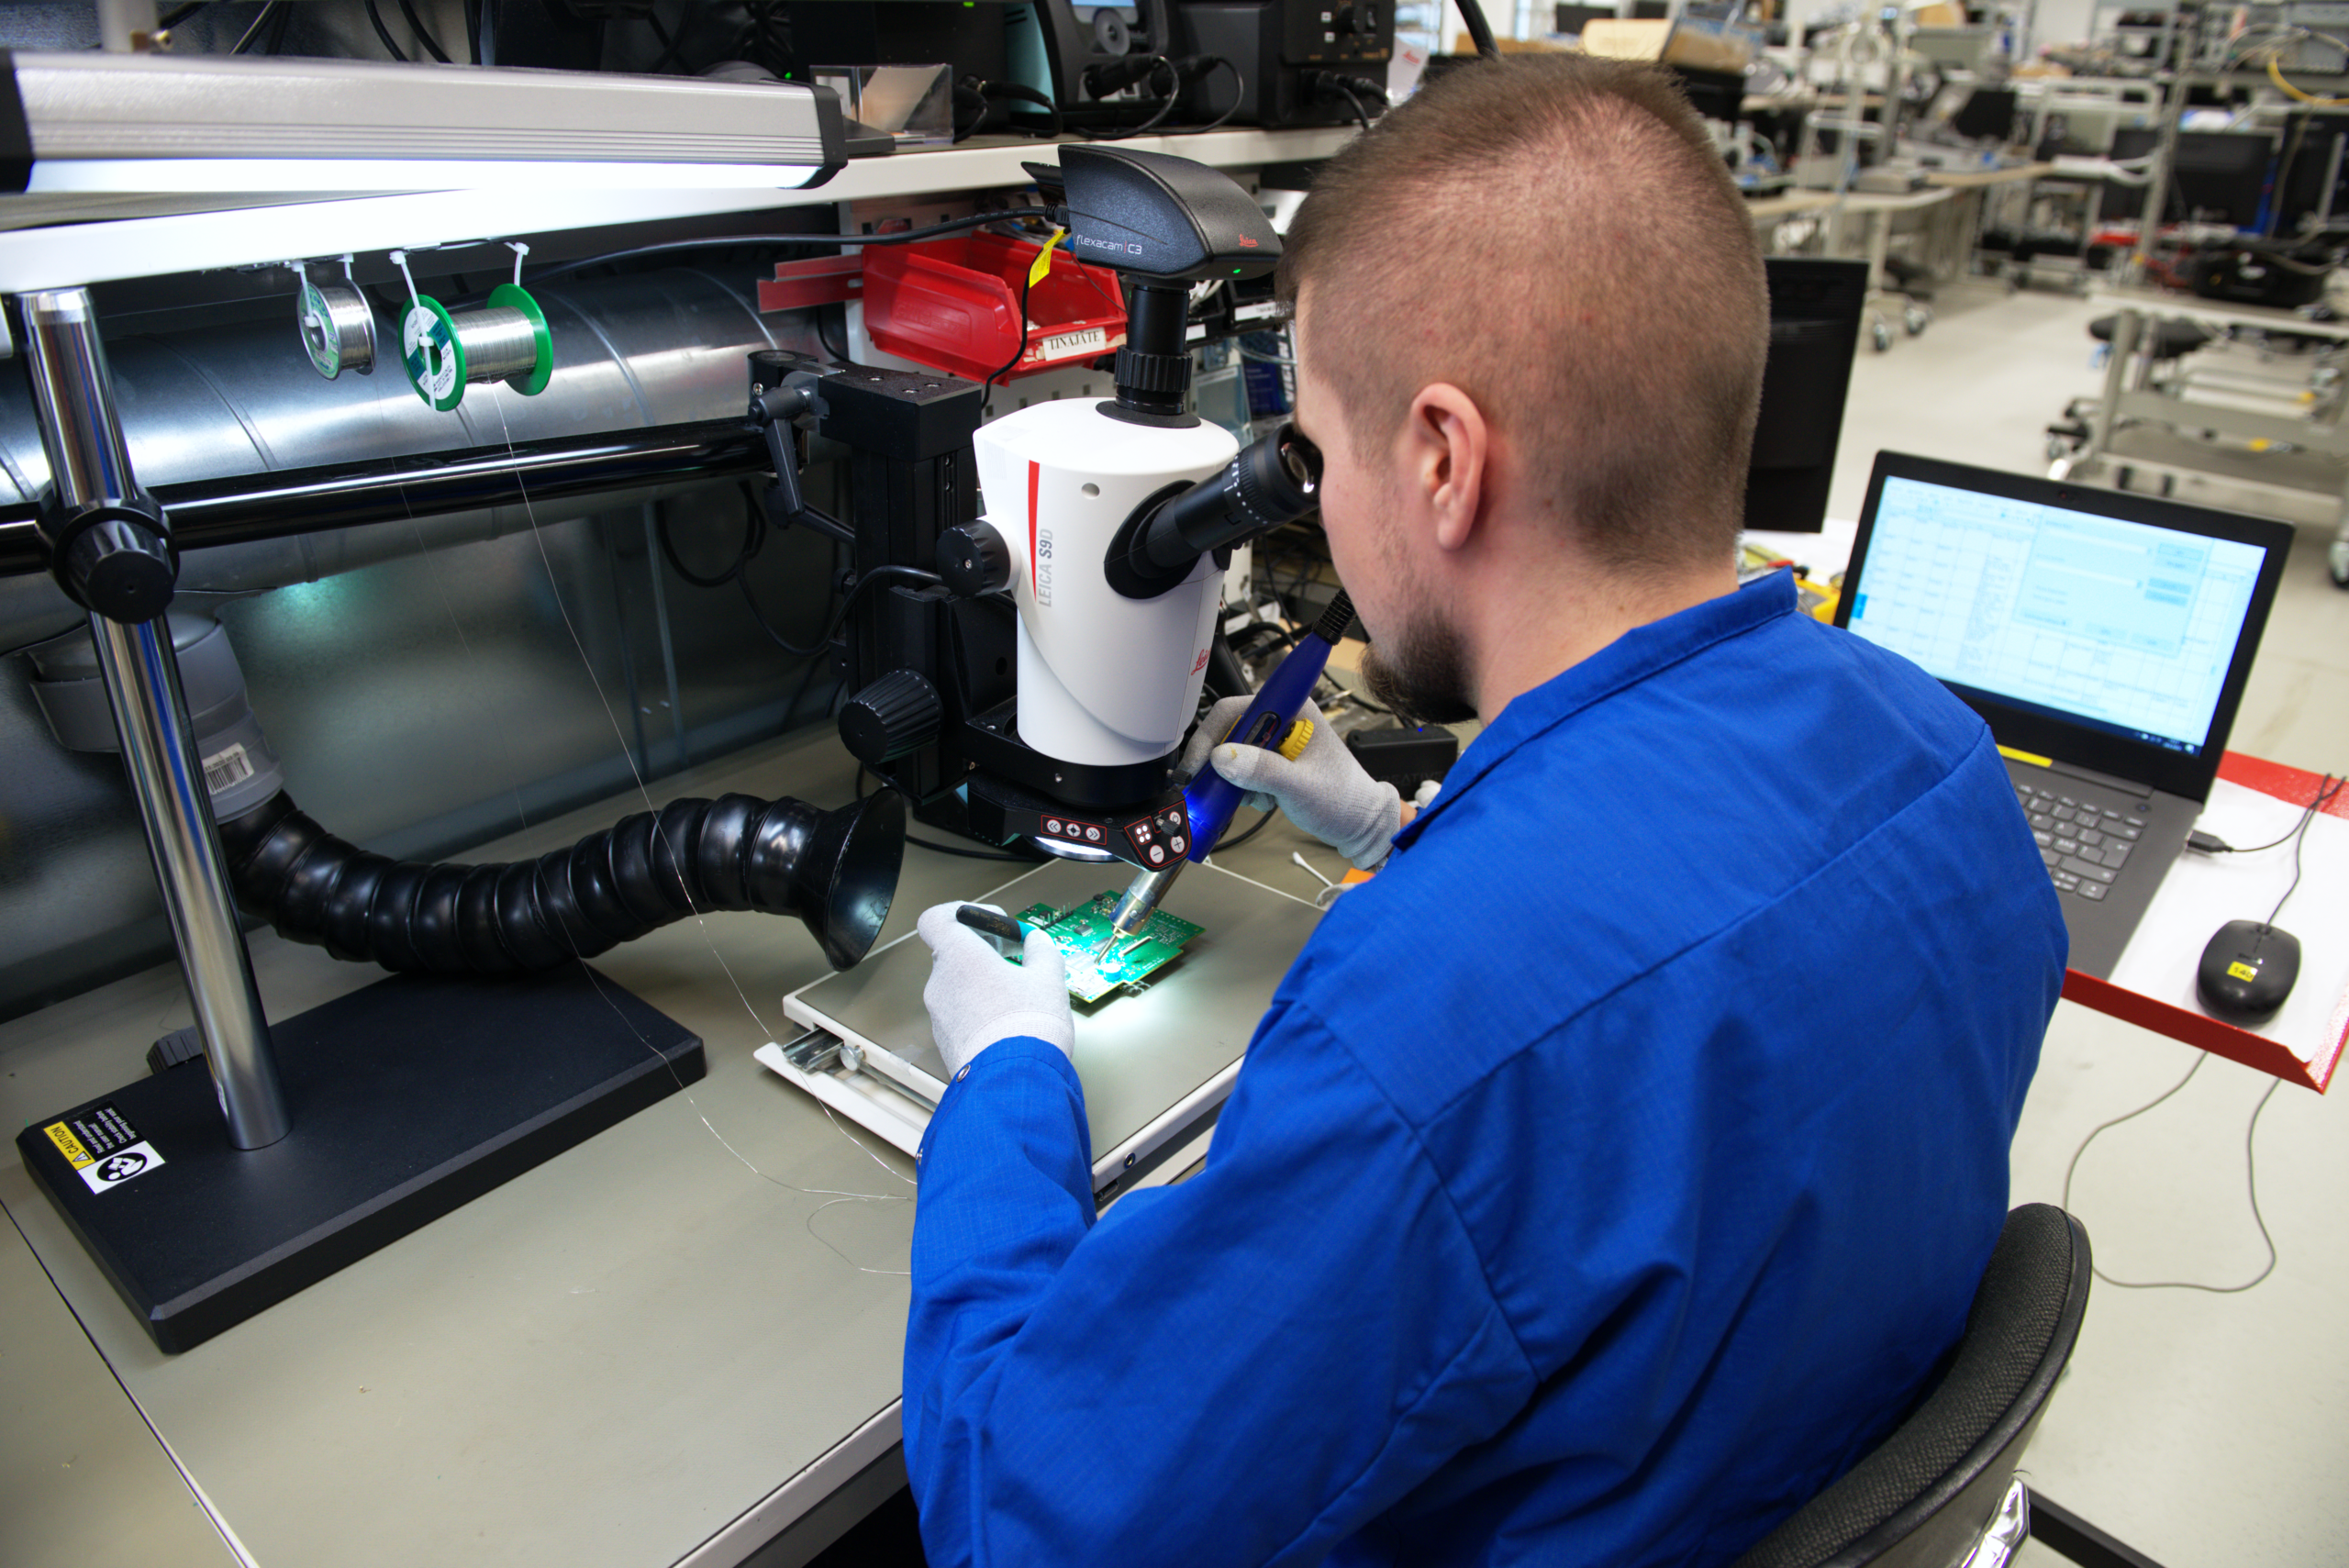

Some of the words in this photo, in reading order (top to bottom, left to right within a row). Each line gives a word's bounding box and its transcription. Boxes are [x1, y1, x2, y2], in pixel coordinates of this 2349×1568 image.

[1239, 233, 1259, 248] Leica
[1038, 528, 1053, 559] S9D
[1038, 563, 1052, 607] LEICA
[95, 1111, 108, 1121] before
[73, 1120, 93, 1138] understand
[105, 1120, 118, 1133] stability
[119, 1122, 136, 1139] beginning
[50, 1126, 79, 1154] CAUTION
[114, 1132, 127, 1143] Check
[93, 1143, 105, 1153] Read
